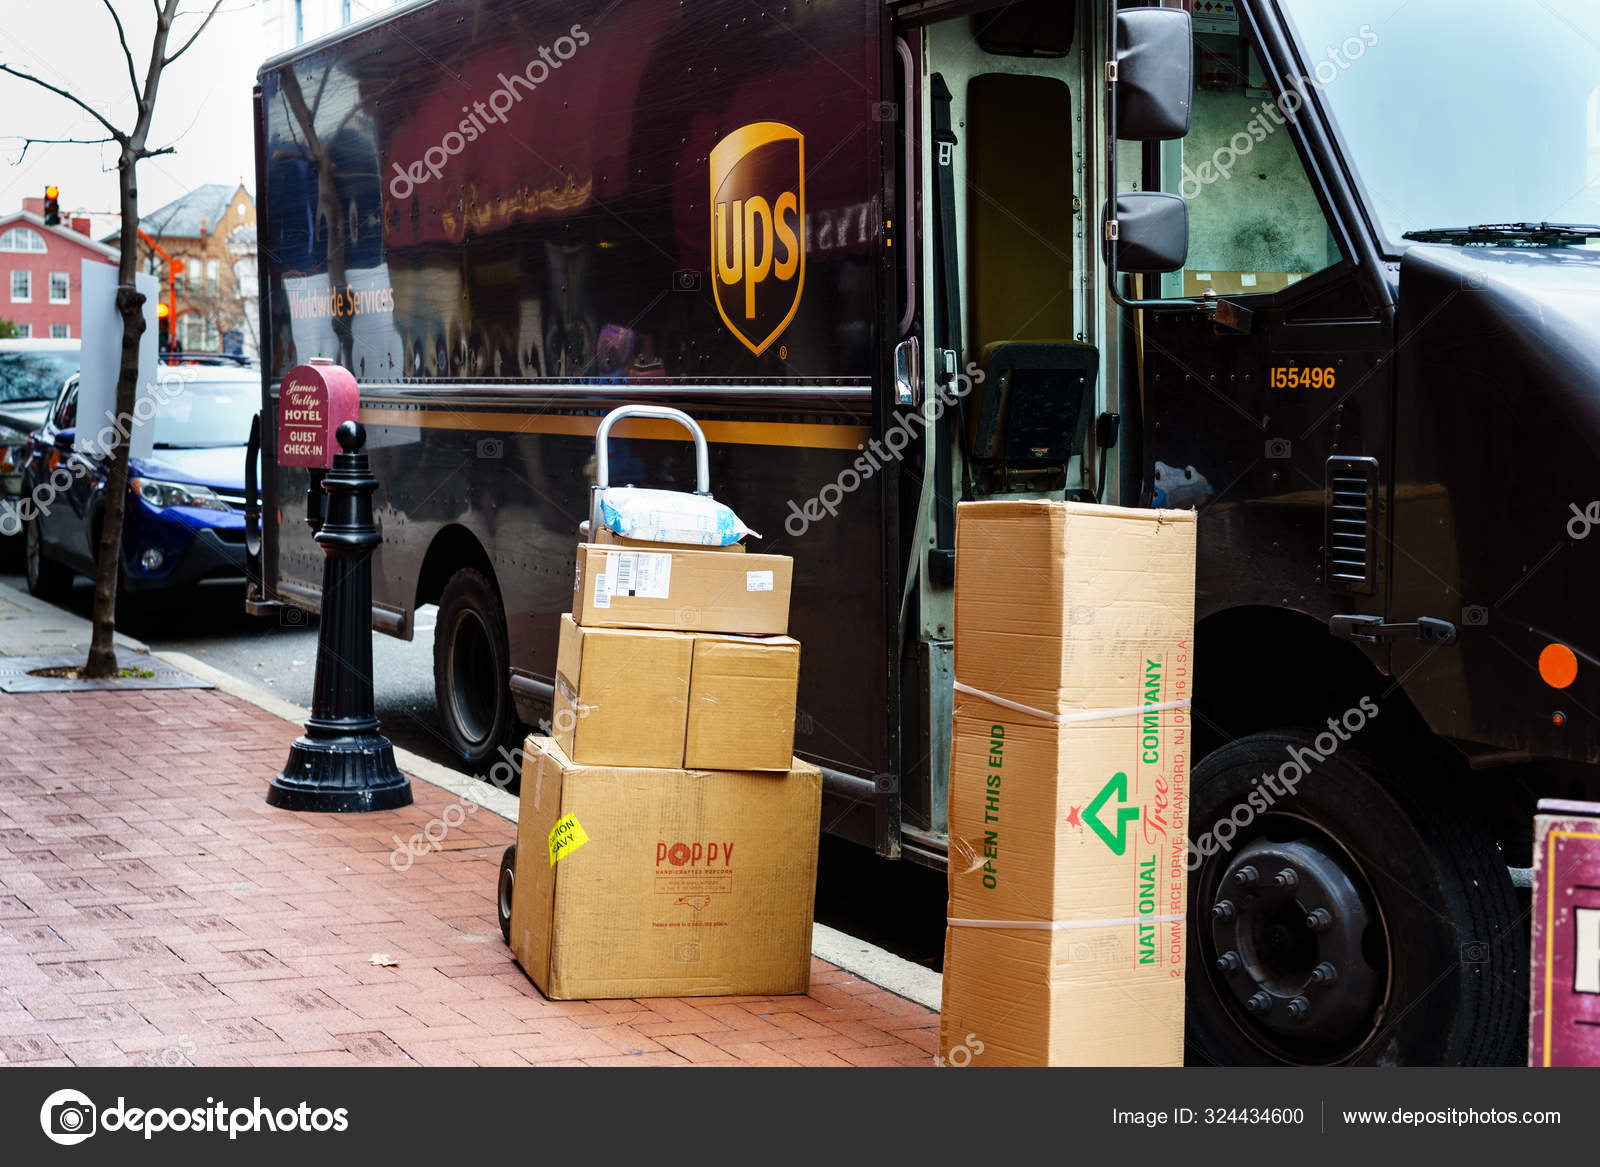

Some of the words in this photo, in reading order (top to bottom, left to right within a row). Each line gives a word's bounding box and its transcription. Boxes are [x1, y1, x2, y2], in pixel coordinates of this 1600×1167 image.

[288, 285, 344, 320] Worldwide
[346, 280, 395, 316] Services
[286, 380, 319, 396] James
[284, 409, 322, 421] HOTEL
[290, 431, 317, 442] GUEST
[283, 444, 323, 456] CHECK-IN
[1173, 680, 1187, 724] 0716
[989, 724, 1005, 768] END
[1173, 728, 1185, 745] NJ
[985, 774, 1001, 824] THIS
[1143, 774, 1169, 845] Tree
[655, 842, 735, 867] POPPY
[982, 830, 998, 890] OPEN
[1169, 968, 1181, 978] 2
